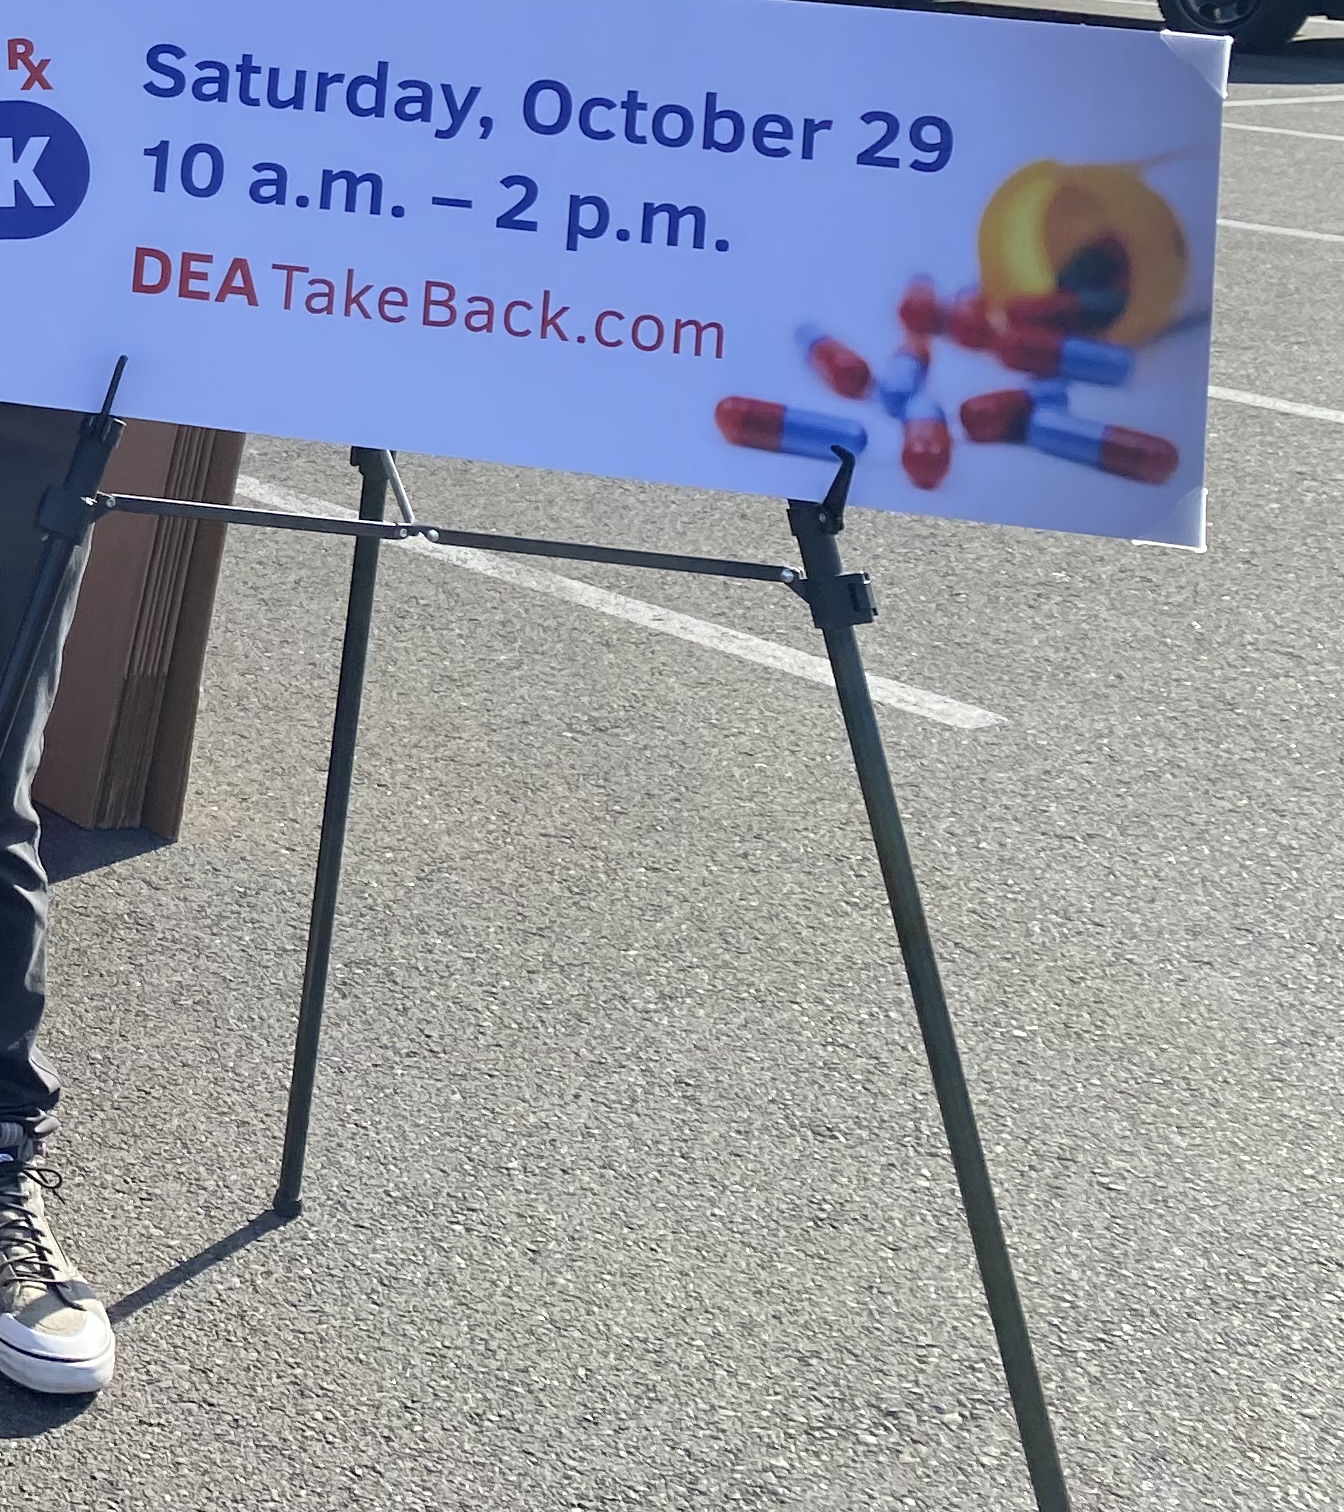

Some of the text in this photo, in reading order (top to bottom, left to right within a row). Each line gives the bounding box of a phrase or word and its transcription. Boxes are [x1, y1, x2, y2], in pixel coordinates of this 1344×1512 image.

[142, 43, 955, 173] Saturday, October 29
[142, 139, 225, 199] 10
[248, 162, 407, 219] a.m.
[495, 174, 540, 233] 2
[565, 192, 732, 253] p.m.
